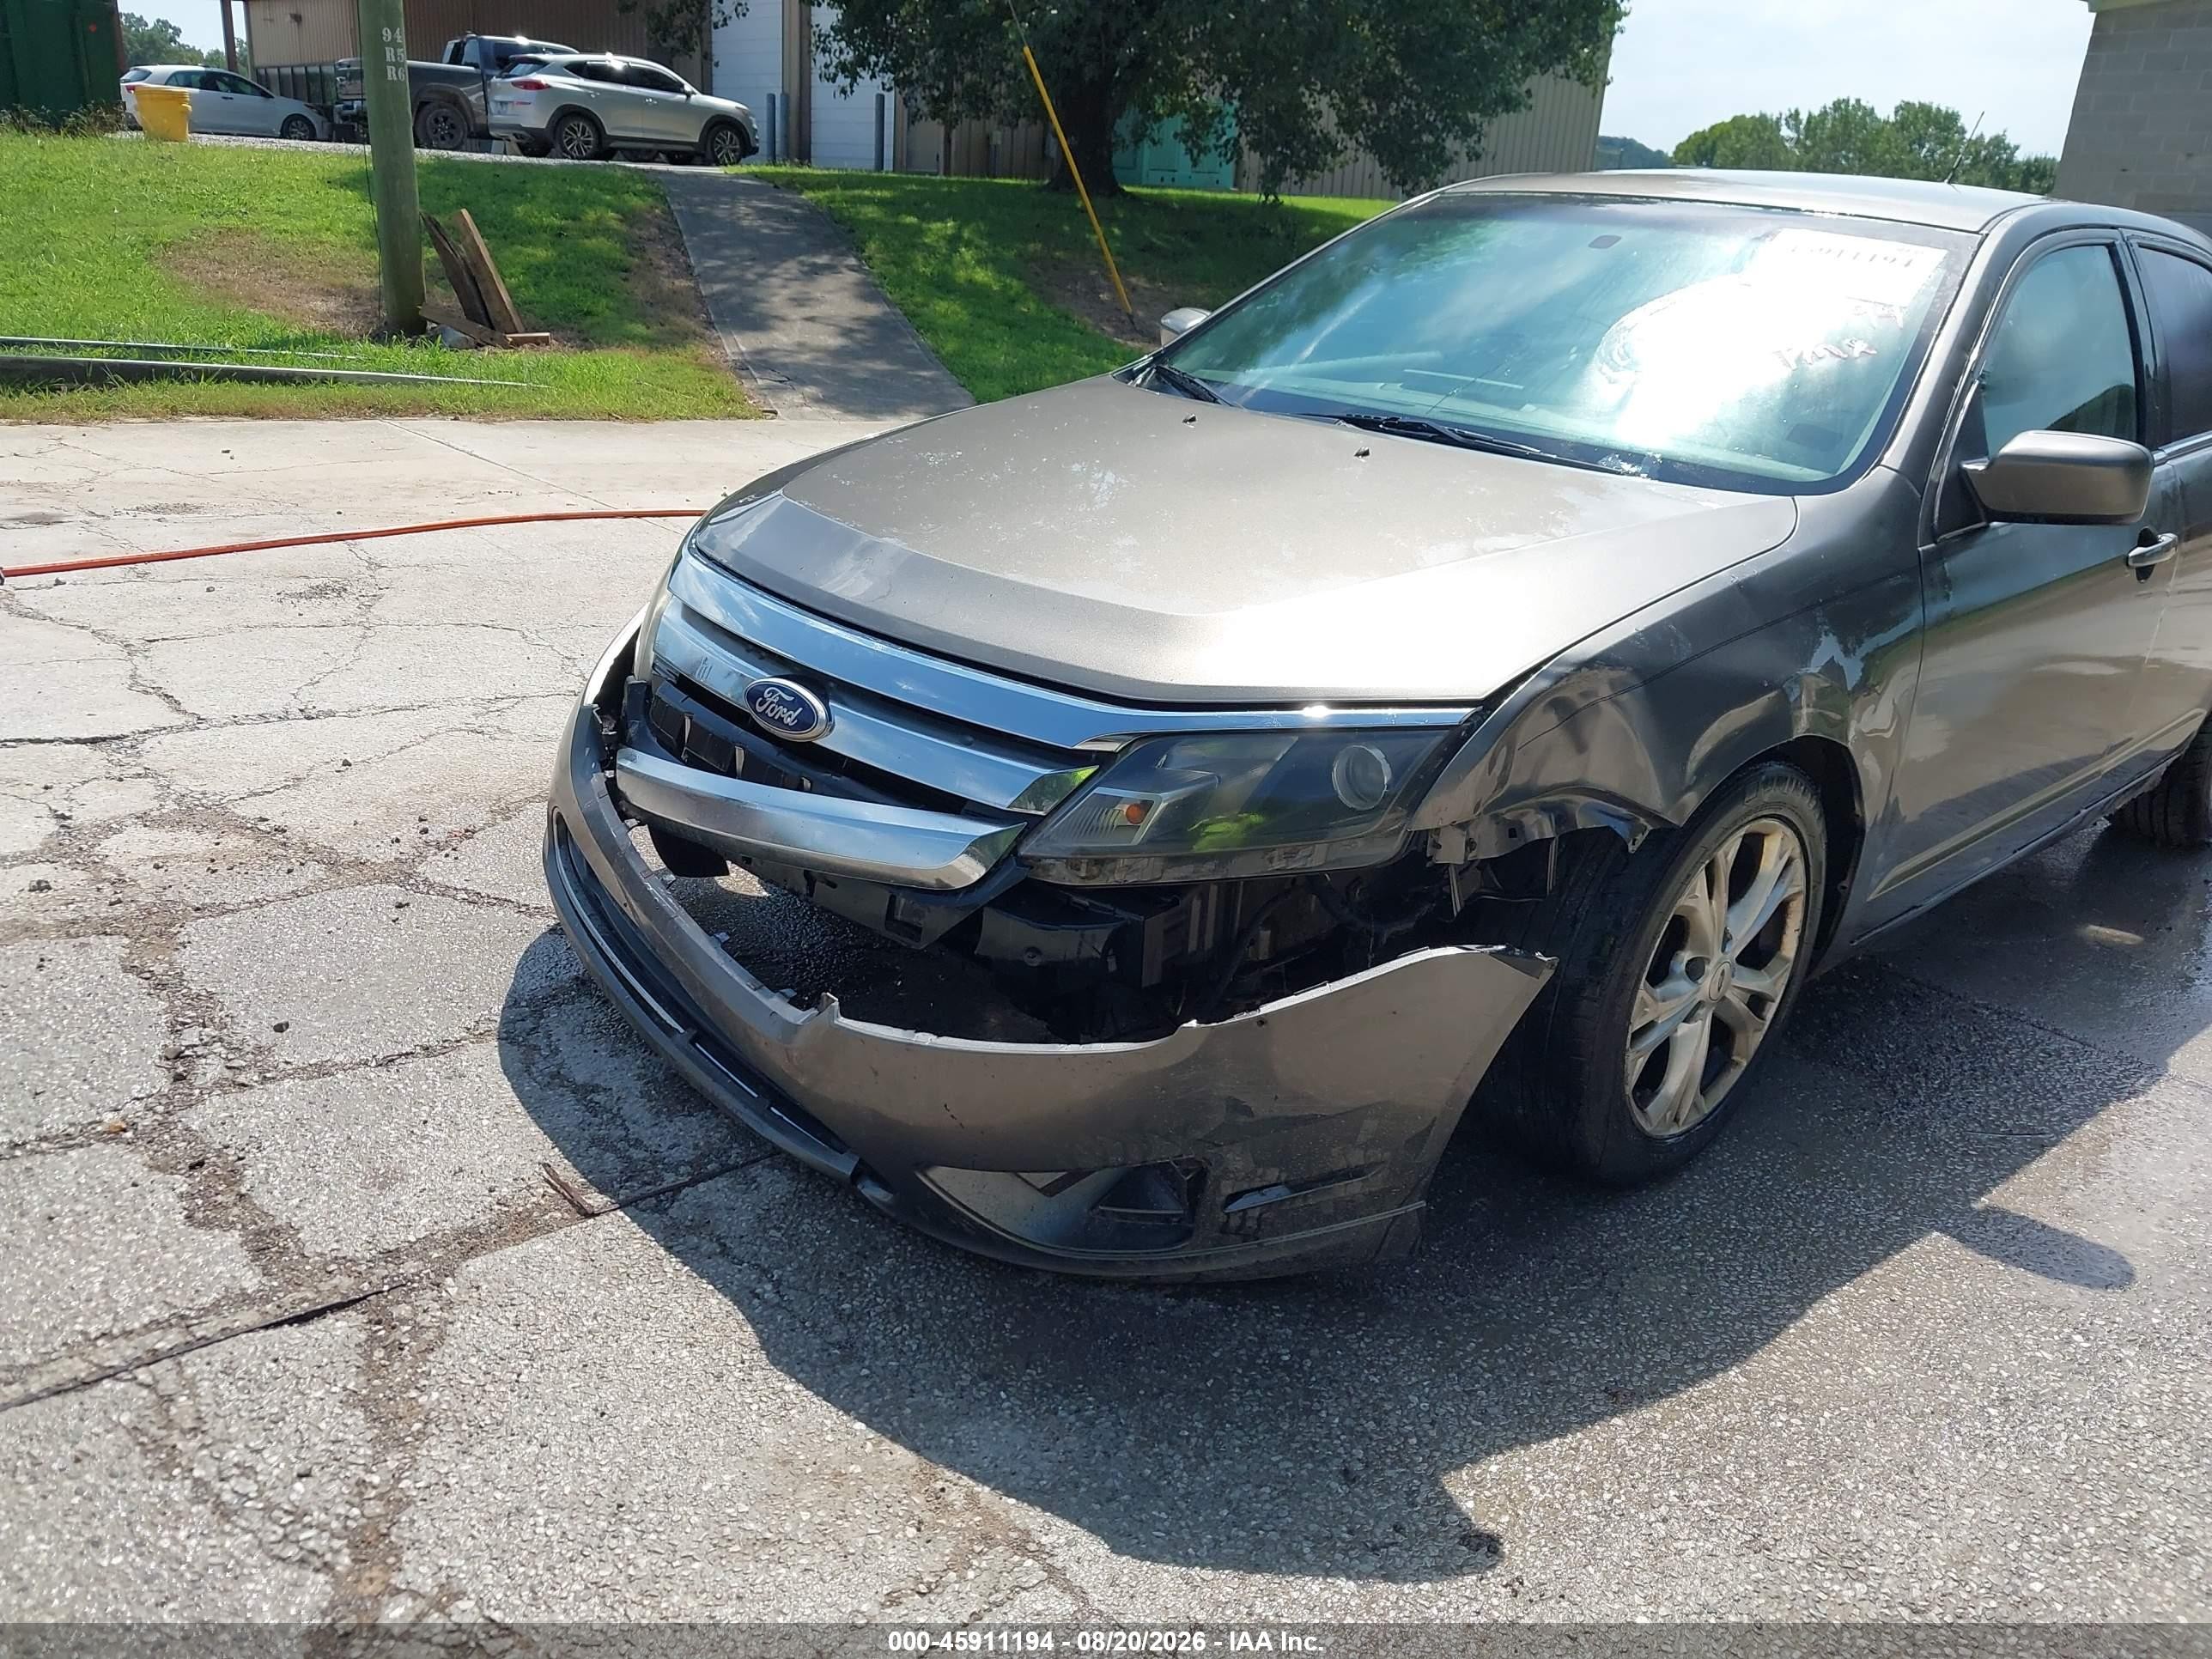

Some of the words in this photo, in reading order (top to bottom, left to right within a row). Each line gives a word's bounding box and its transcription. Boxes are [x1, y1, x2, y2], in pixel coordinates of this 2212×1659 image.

[381, 27, 403, 43] 94
[385, 46, 404, 63] R5
[386, 65, 405, 82] R6
[756, 687, 803, 726] Ford
